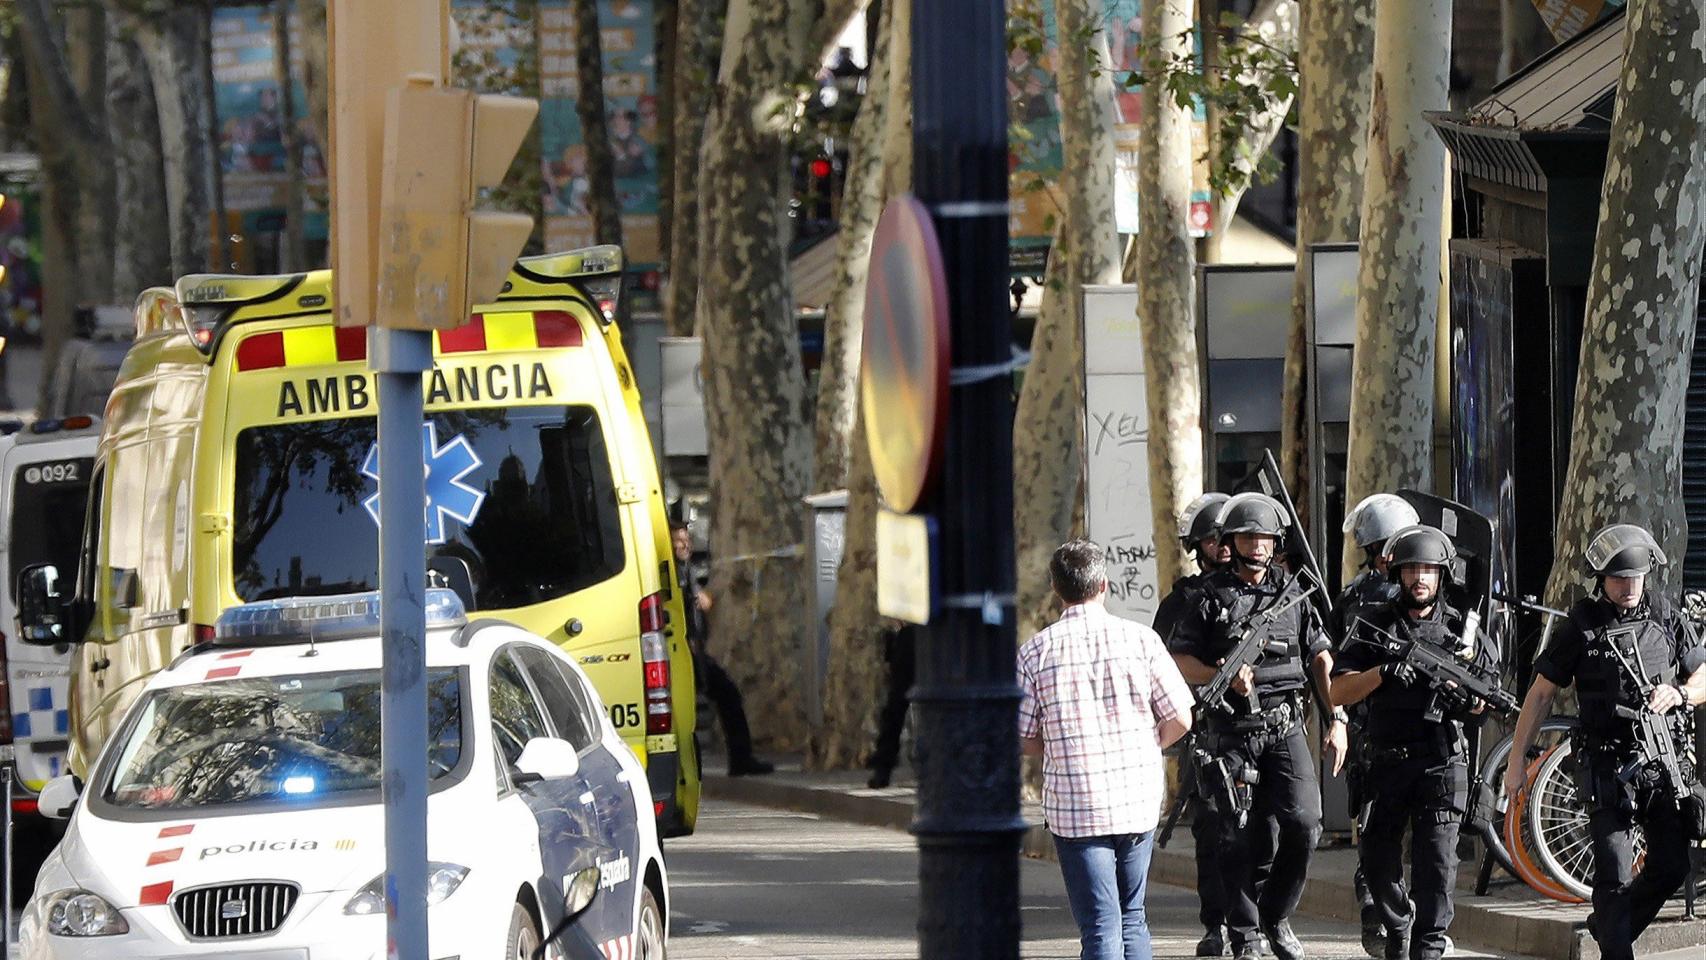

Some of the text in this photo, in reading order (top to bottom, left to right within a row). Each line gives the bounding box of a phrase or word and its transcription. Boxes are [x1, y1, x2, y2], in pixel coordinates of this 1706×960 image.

[277, 362, 553, 417] AMBÀNCIA
[42, 462, 78, 482] 092
[604, 703, 640, 728] 05
[199, 838, 319, 861] policia
